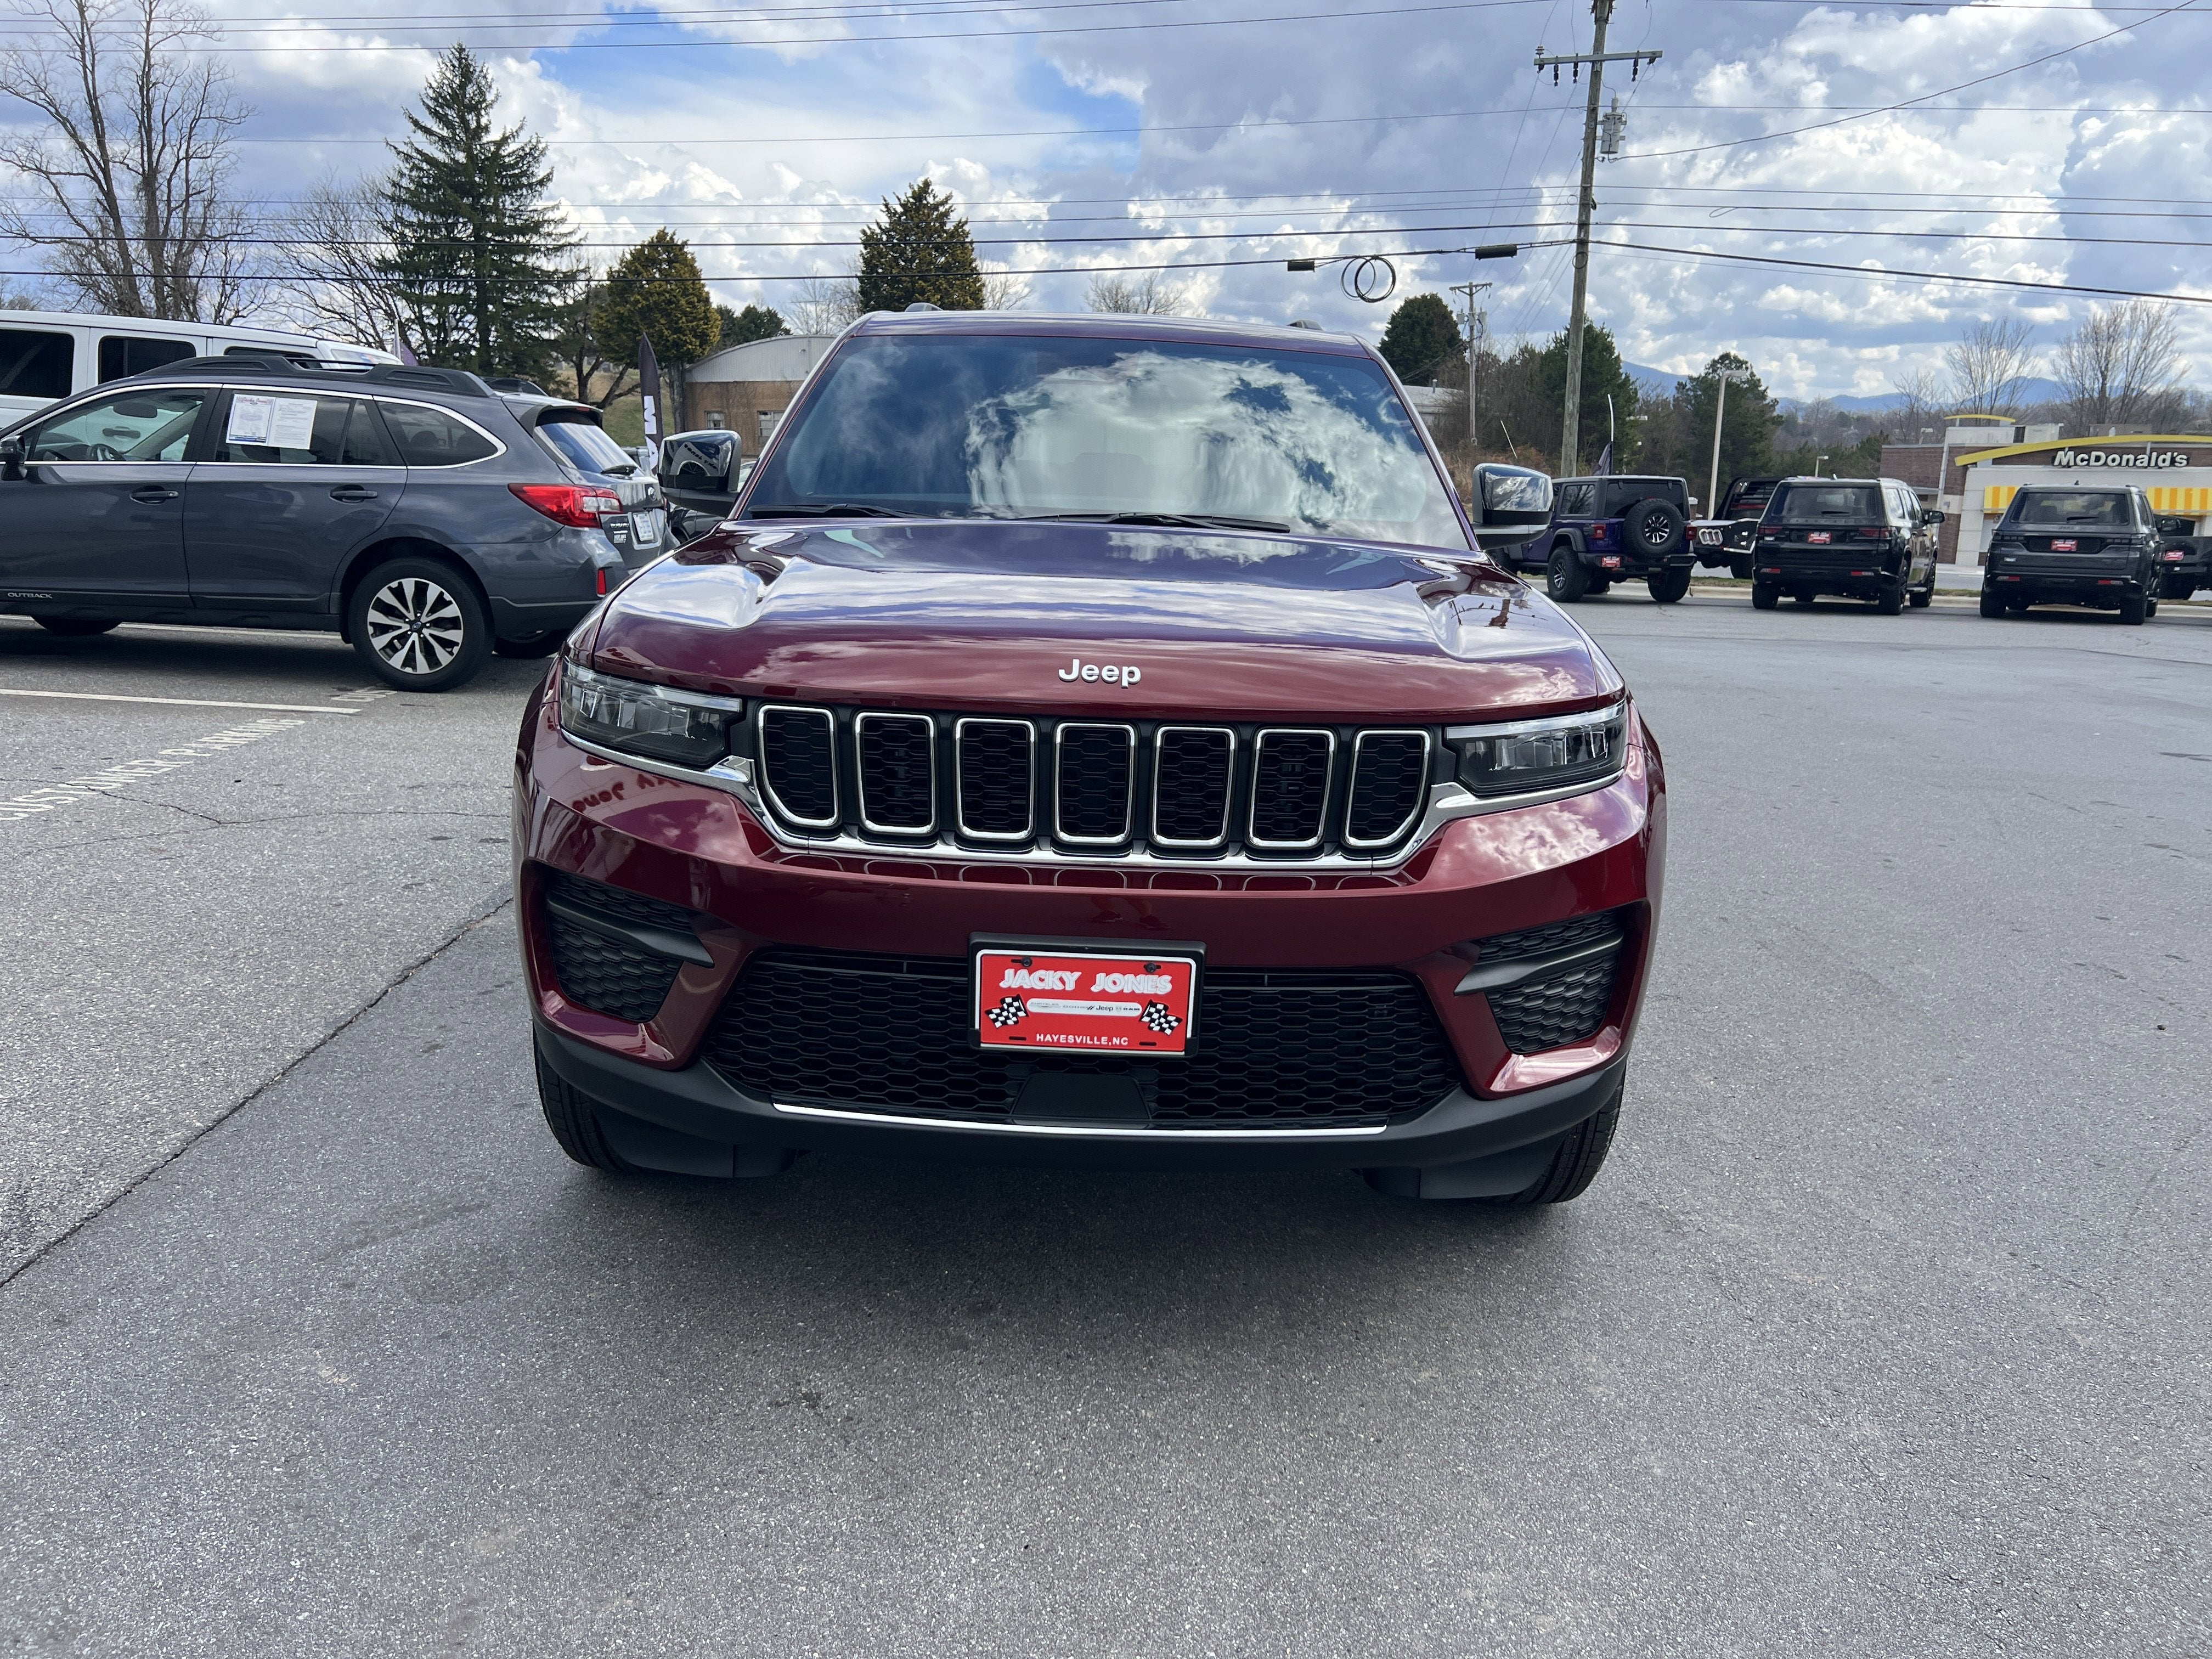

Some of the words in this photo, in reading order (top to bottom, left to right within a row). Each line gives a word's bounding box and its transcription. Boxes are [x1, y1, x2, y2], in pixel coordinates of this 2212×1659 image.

[2053, 450, 2188, 467] McDonald's
[1058, 658, 1142, 689] Jeep
[998, 968, 1082, 991] JACKY
[1090, 972, 1173, 995] JONES
